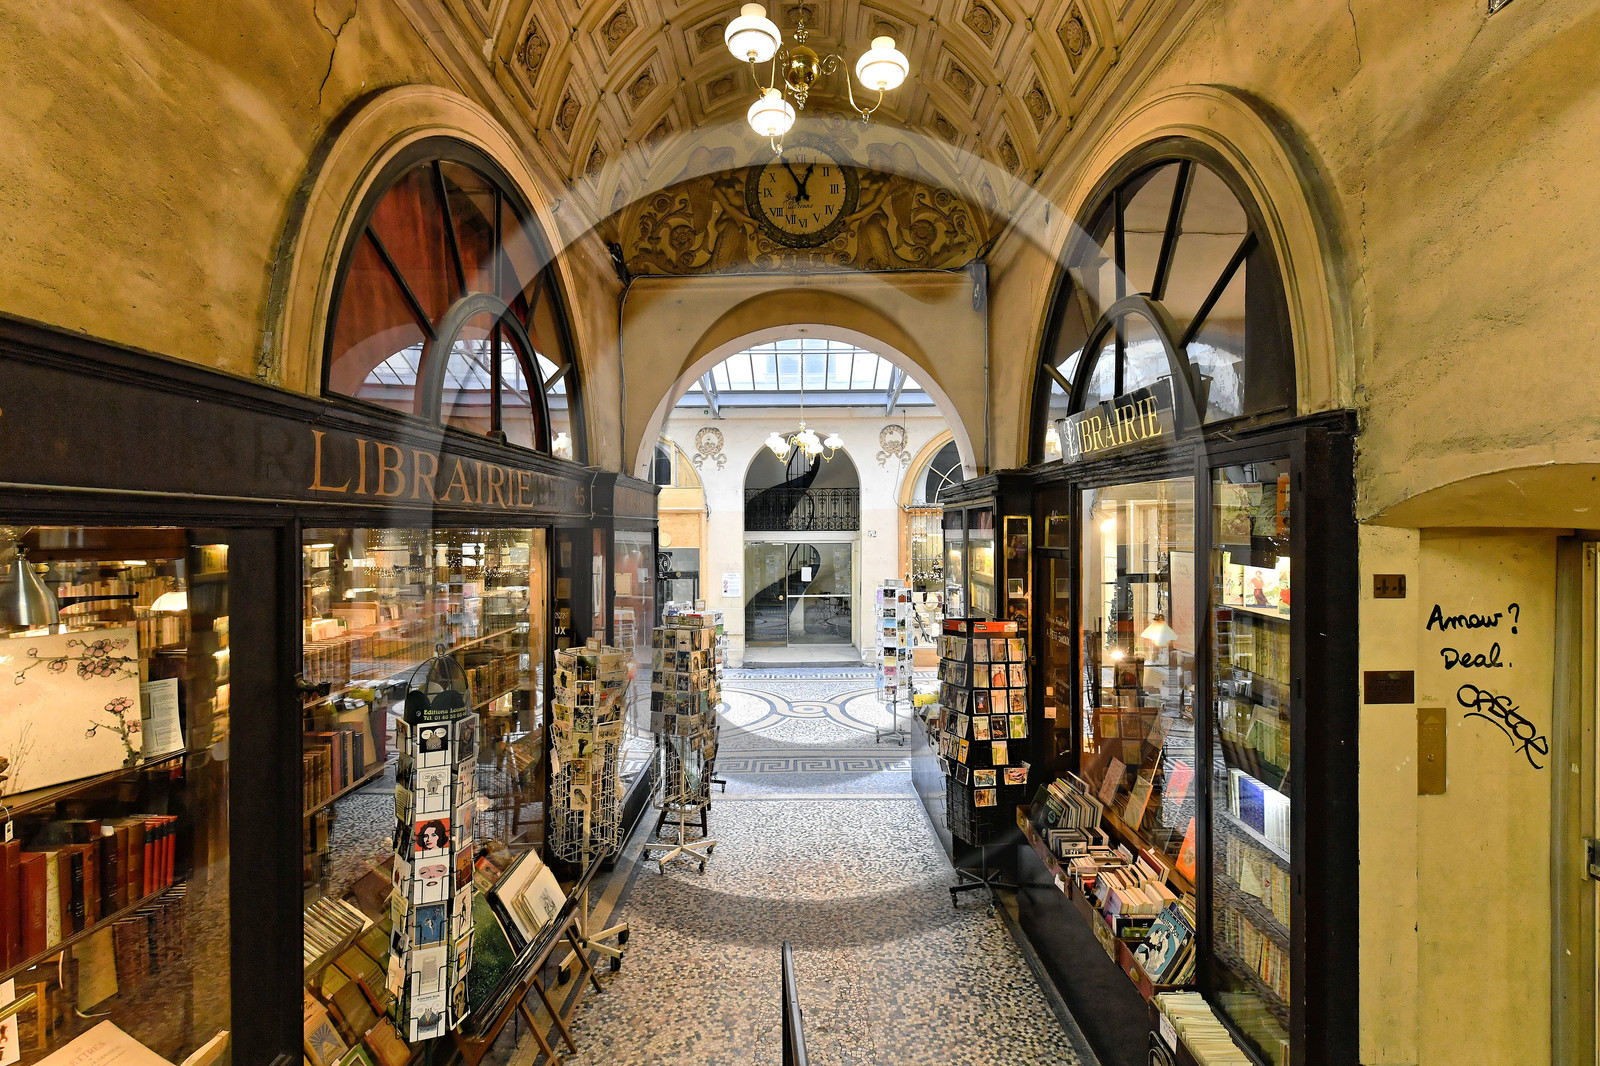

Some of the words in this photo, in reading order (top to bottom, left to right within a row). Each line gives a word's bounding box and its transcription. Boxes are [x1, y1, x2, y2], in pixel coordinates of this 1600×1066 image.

[823, 167, 830, 177] II
[769, 173, 776, 183] X
[763, 188, 773, 198] IX
[830, 184, 839, 194] III
[769, 207, 783, 217] VIII
[825, 205, 835, 215] IV
[785, 214, 796, 225] VII
[798, 218, 808, 228] VI
[812, 213, 821, 223] V
[1064, 395, 1163, 461] LIBRAIRIE
[308, 429, 534, 508] LIBRAIRIE
